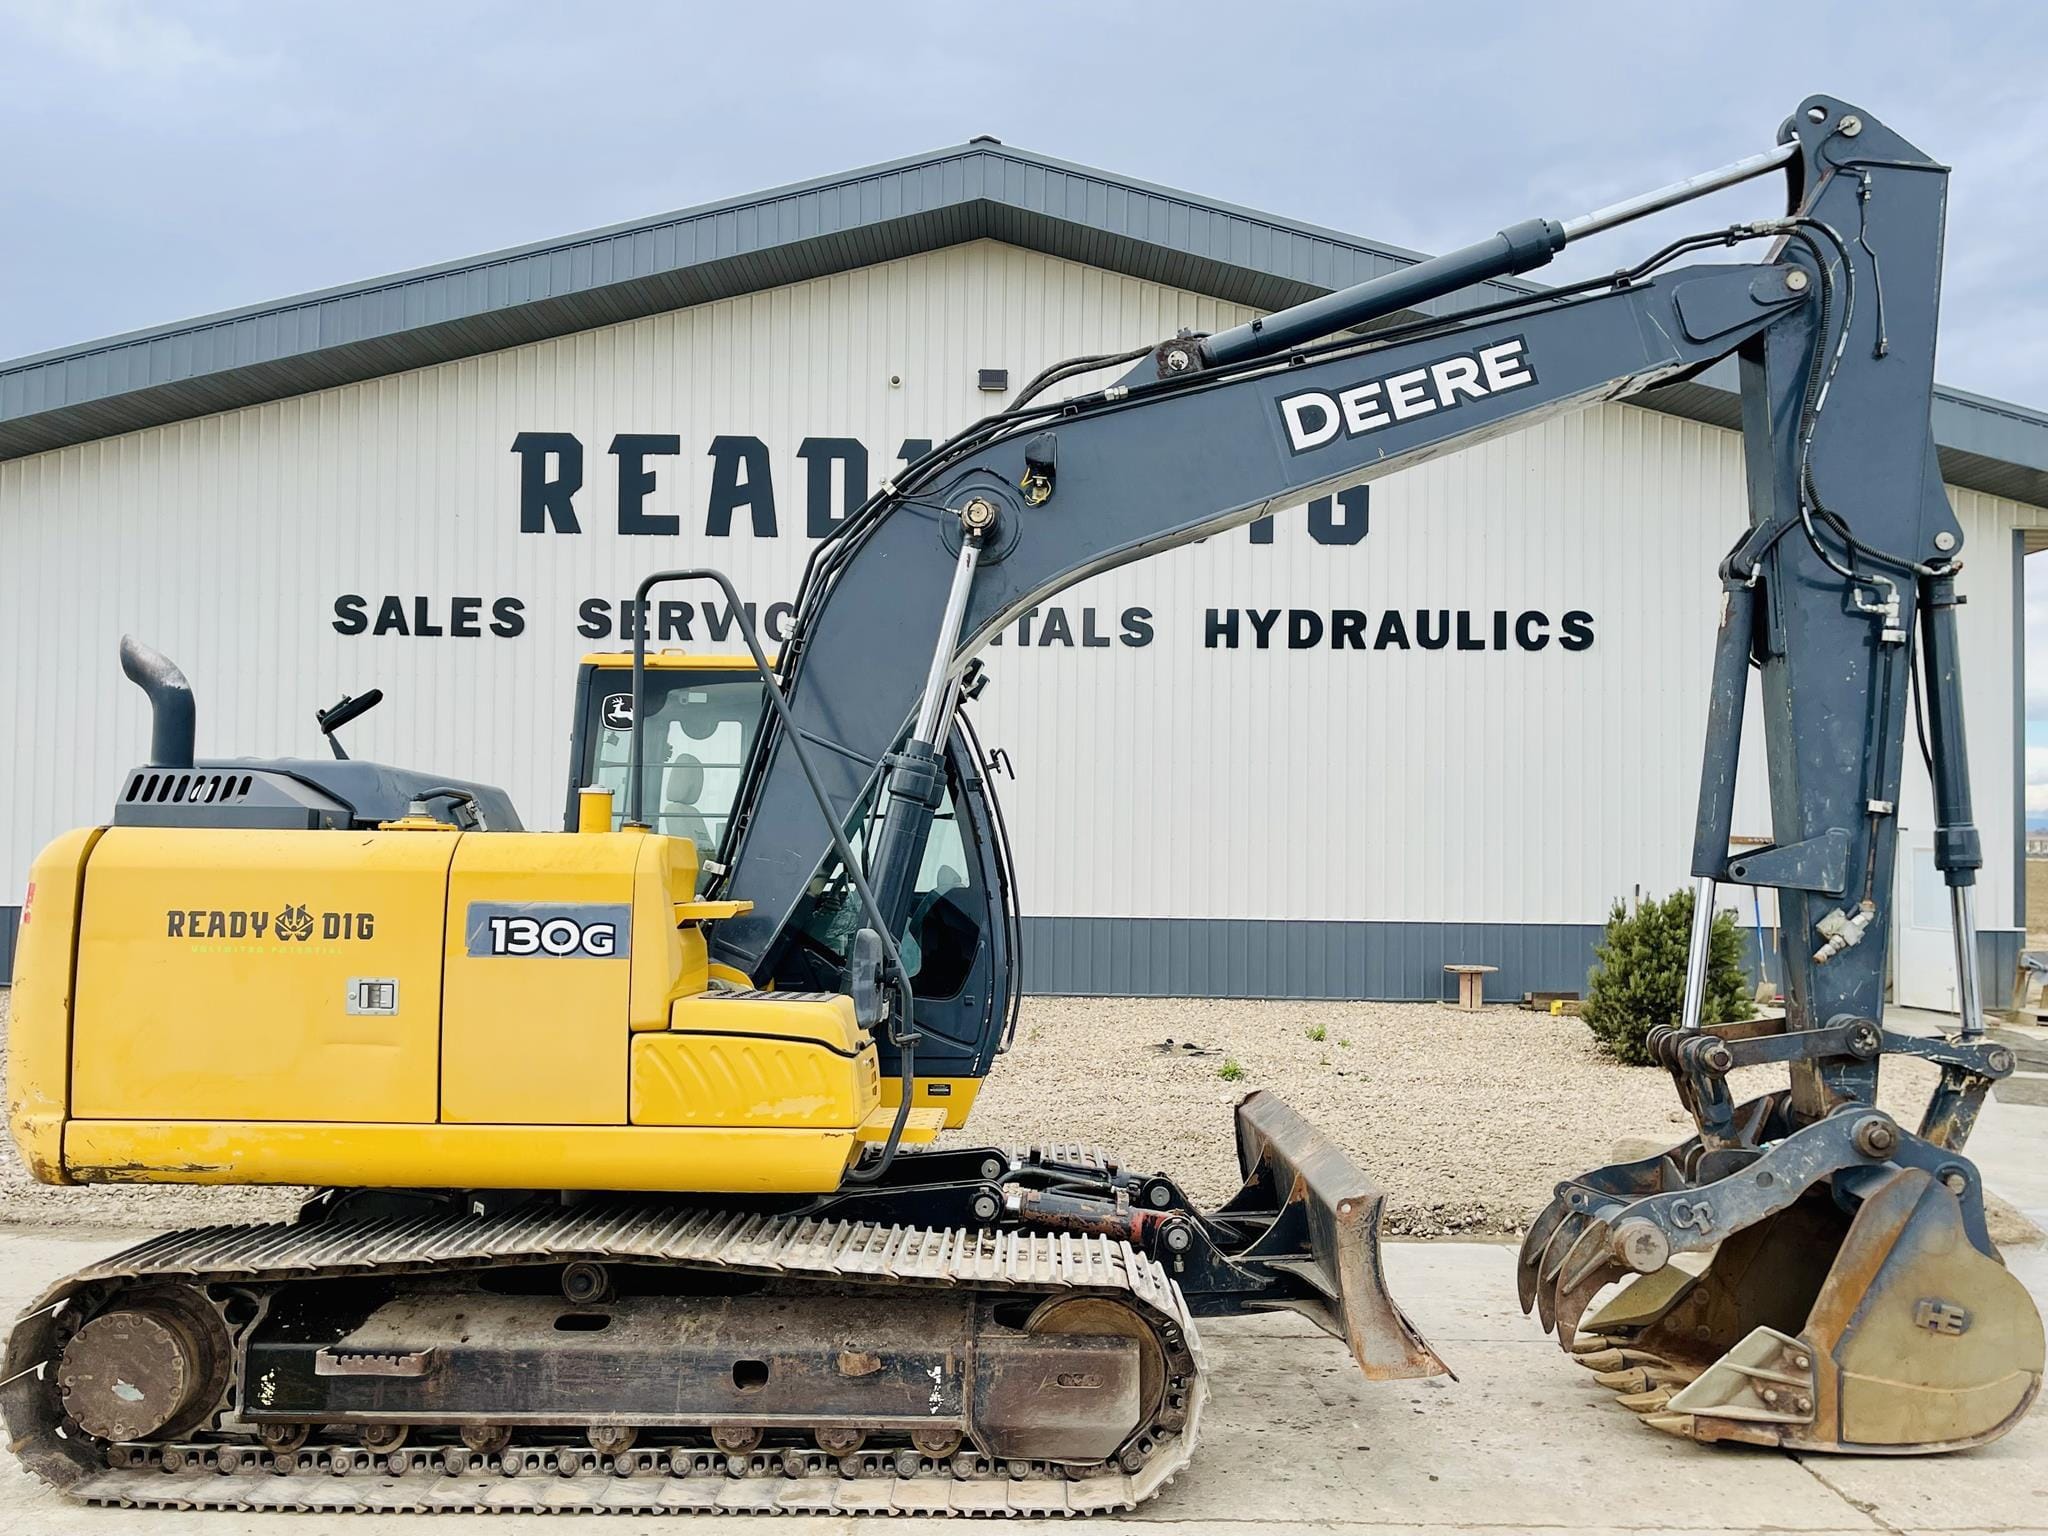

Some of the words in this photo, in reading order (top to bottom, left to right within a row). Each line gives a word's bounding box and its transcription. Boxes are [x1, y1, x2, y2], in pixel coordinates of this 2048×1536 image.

[1279, 337, 1534, 452] DEERE
[511, 432, 933, 538] READ
[332, 595, 525, 639] SALES
[577, 598, 795, 642] SERVIC
[1205, 608, 1594, 652] HYDRAULICS
[167, 911, 269, 938] READY
[322, 912, 375, 940] DIG
[489, 917, 616, 956] 130G
